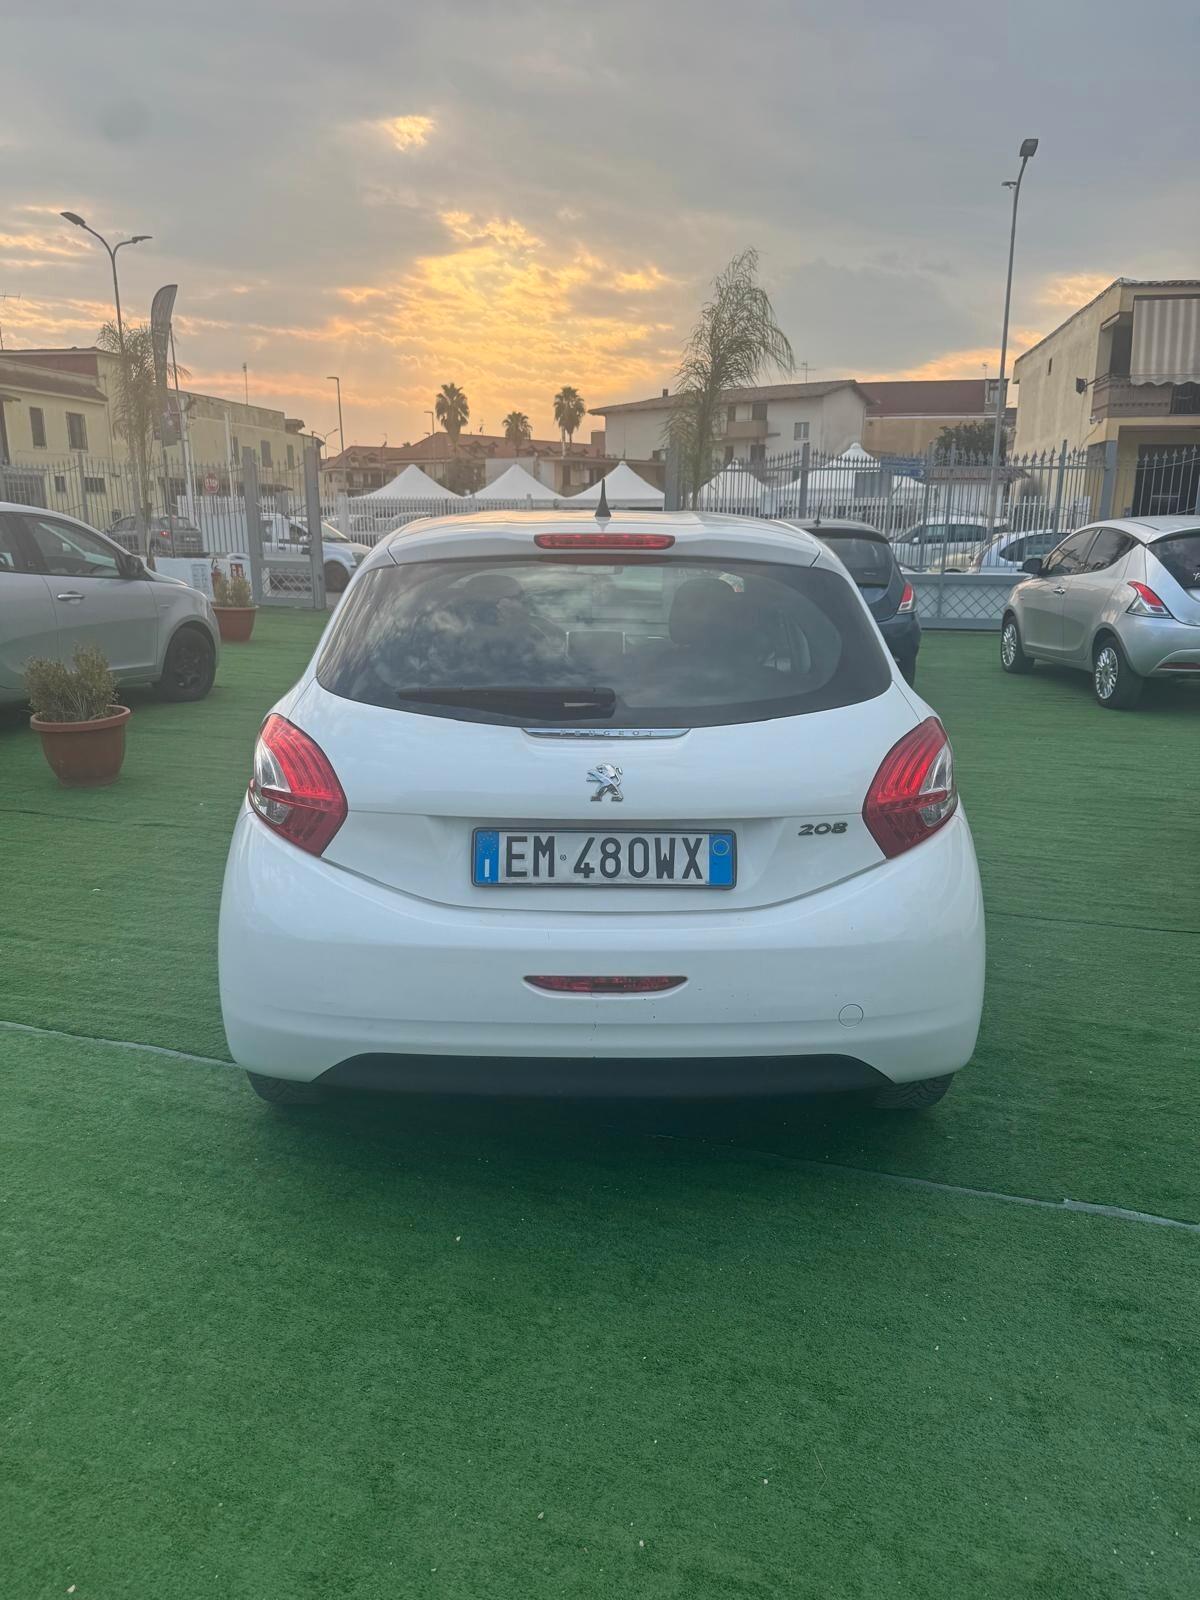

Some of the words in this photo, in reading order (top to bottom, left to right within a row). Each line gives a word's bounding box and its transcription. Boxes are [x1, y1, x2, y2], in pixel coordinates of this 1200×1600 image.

[560, 728, 655, 737] PEUGEOT
[798, 822, 848, 836] 208
[505, 835, 556, 878] EM
[573, 836, 704, 880] 480WX
